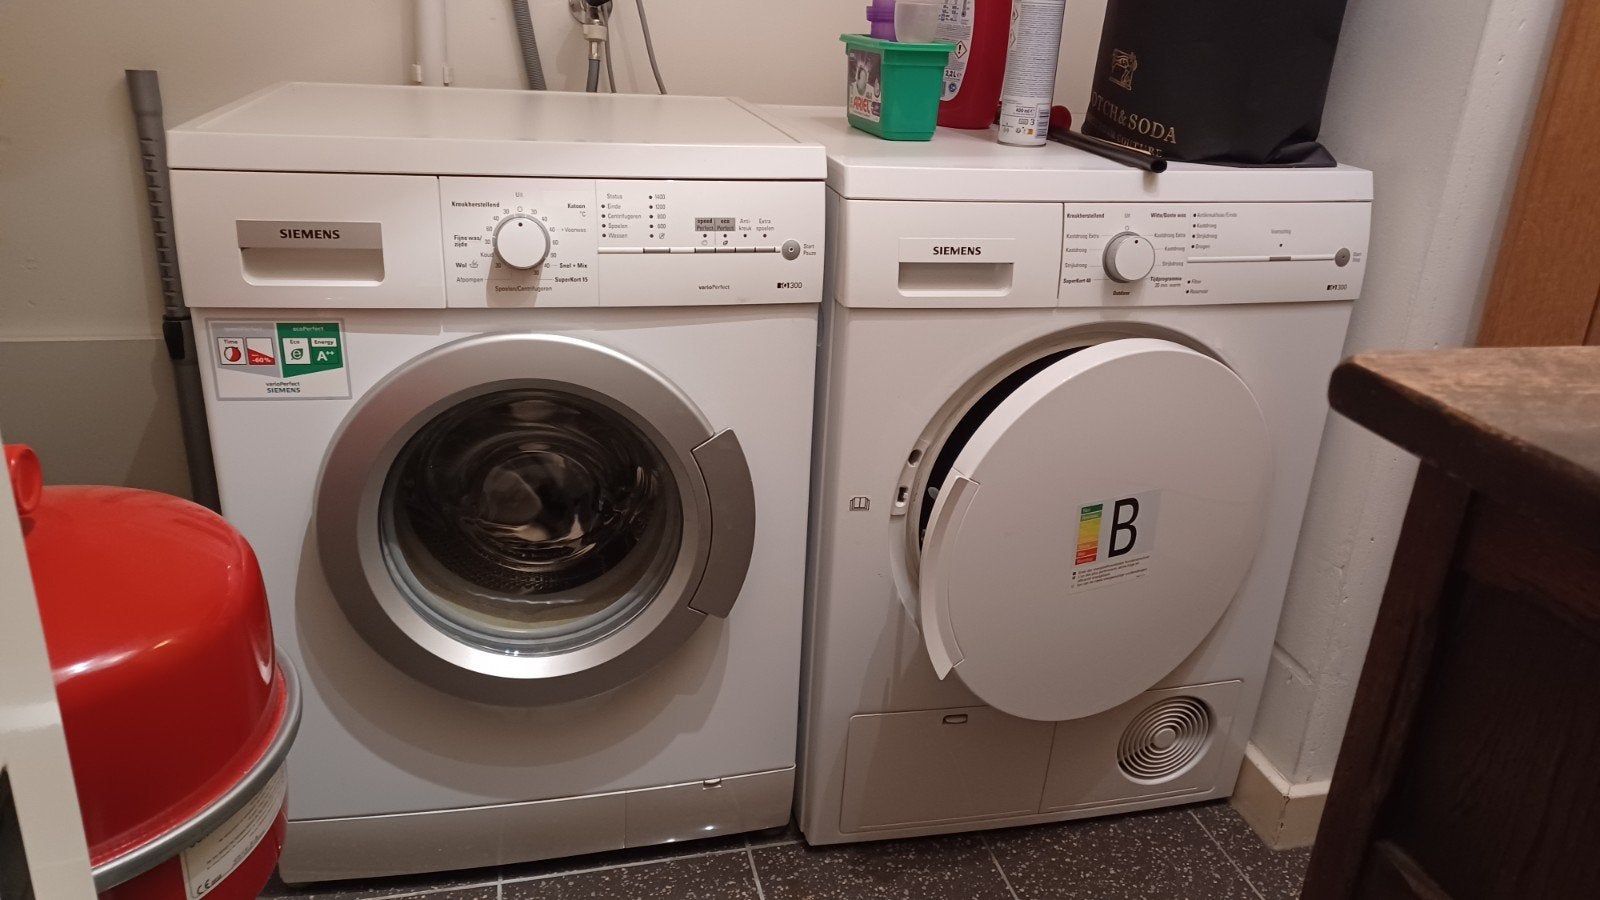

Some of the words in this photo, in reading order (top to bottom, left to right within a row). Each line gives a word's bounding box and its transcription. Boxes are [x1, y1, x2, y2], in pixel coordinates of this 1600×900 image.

[279, 228, 341, 240] SIEMENS
[932, 246, 982, 256] SIEMENS
[1108, 497, 1140, 559] B
